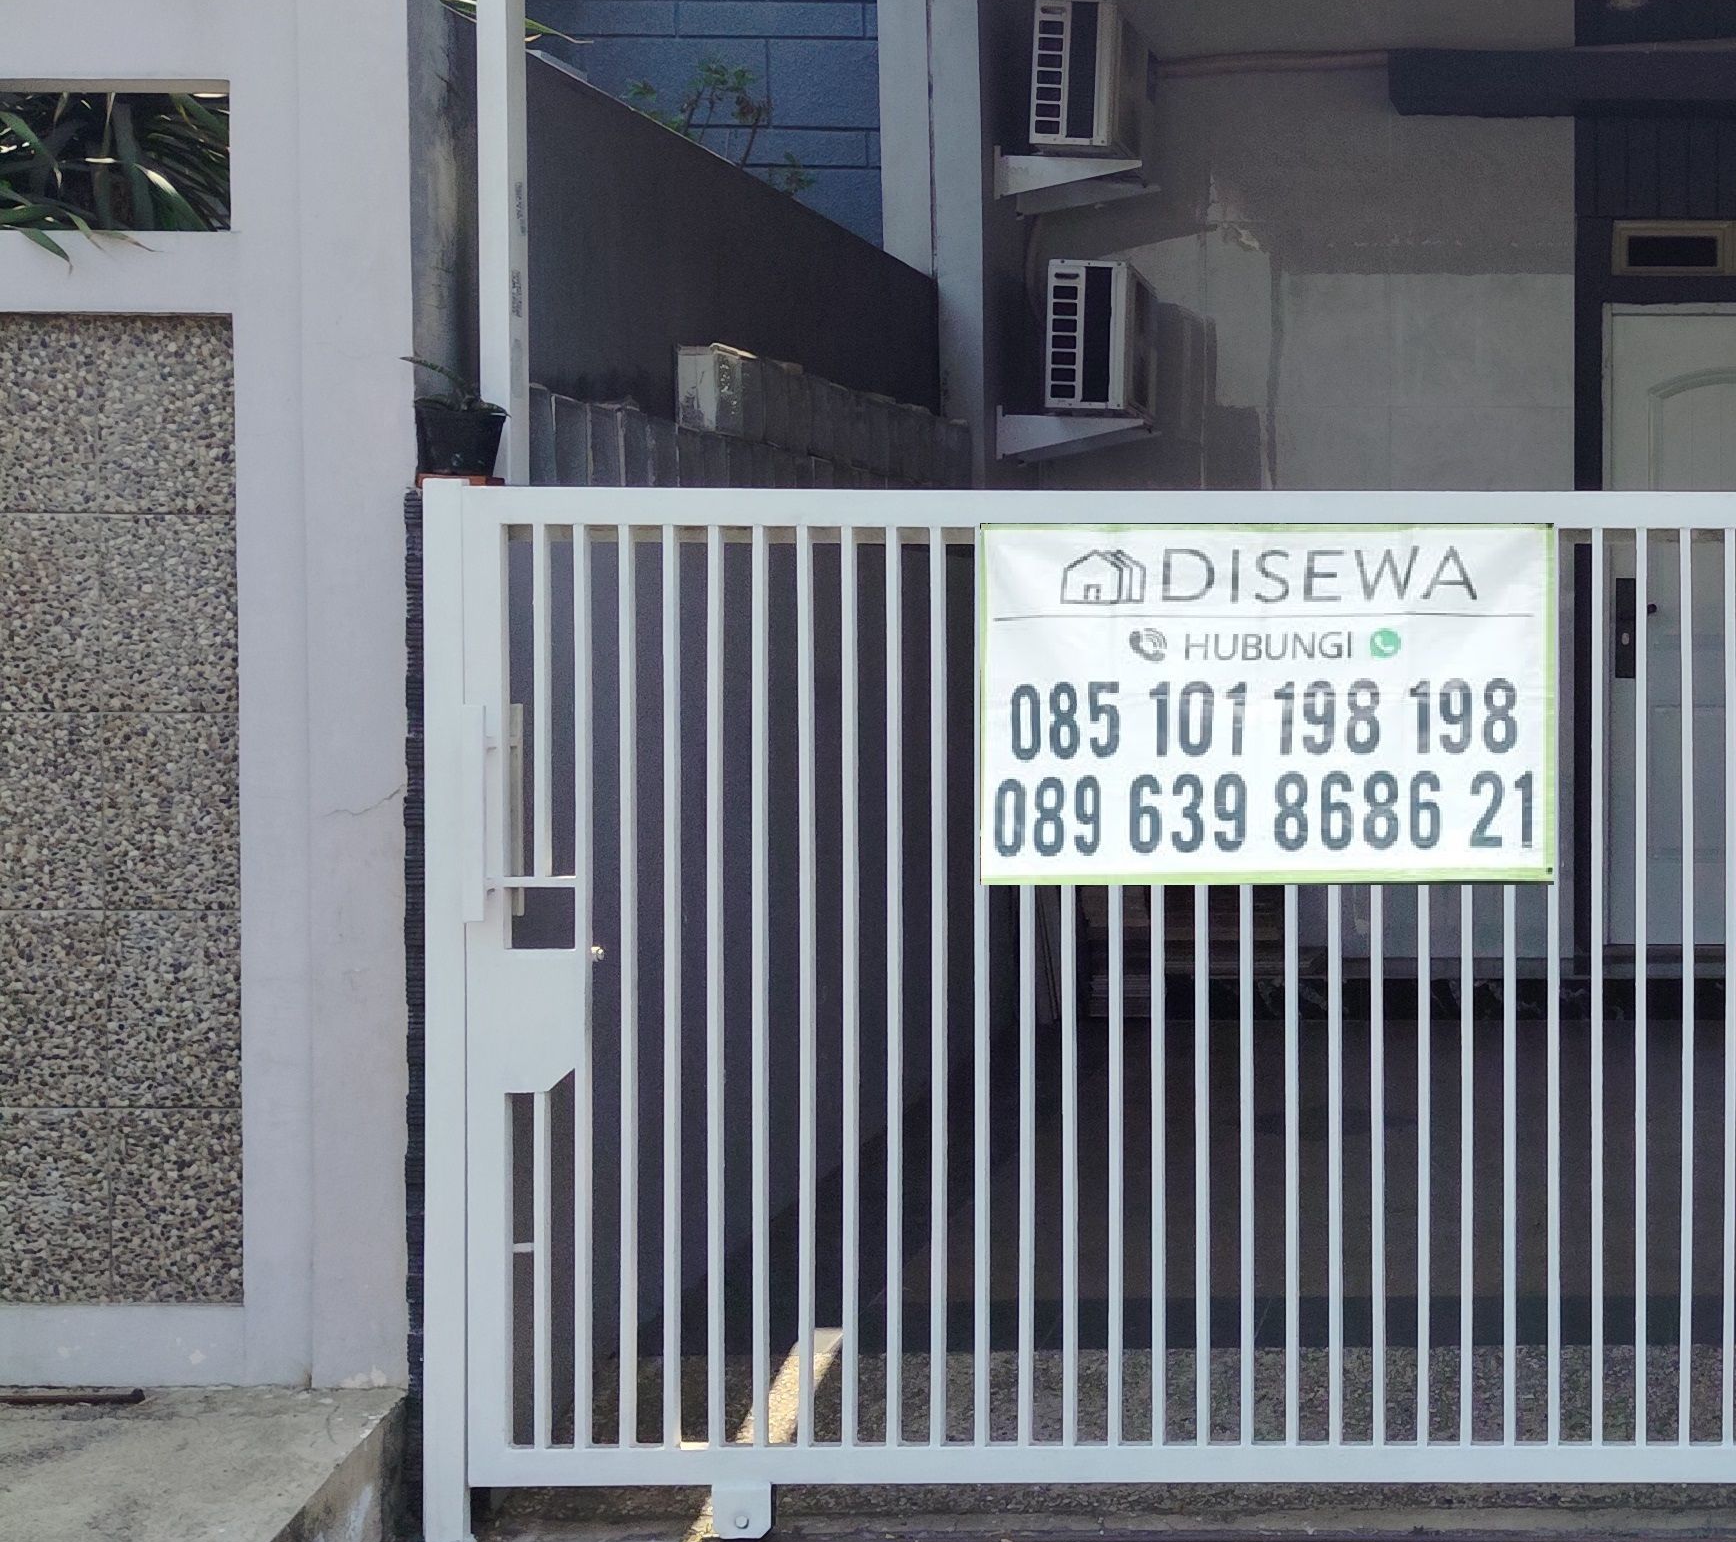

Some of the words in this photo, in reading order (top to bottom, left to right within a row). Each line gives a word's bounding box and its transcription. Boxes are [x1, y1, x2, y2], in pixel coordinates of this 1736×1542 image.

[1162, 545, 1478, 603] DISEWA
[1184, 631, 1352, 661] HUBUNGI
[1011, 681, 1120, 761] 085
[1149, 681, 1248, 757] 101
[1273, 677, 1380, 756] 198
[1409, 677, 1518, 754] 198
[994, 774, 1102, 857] 089
[1129, 773, 1248, 854] 639
[1274, 770, 1441, 853] 8686
[1470, 770, 1534, 849] 21
